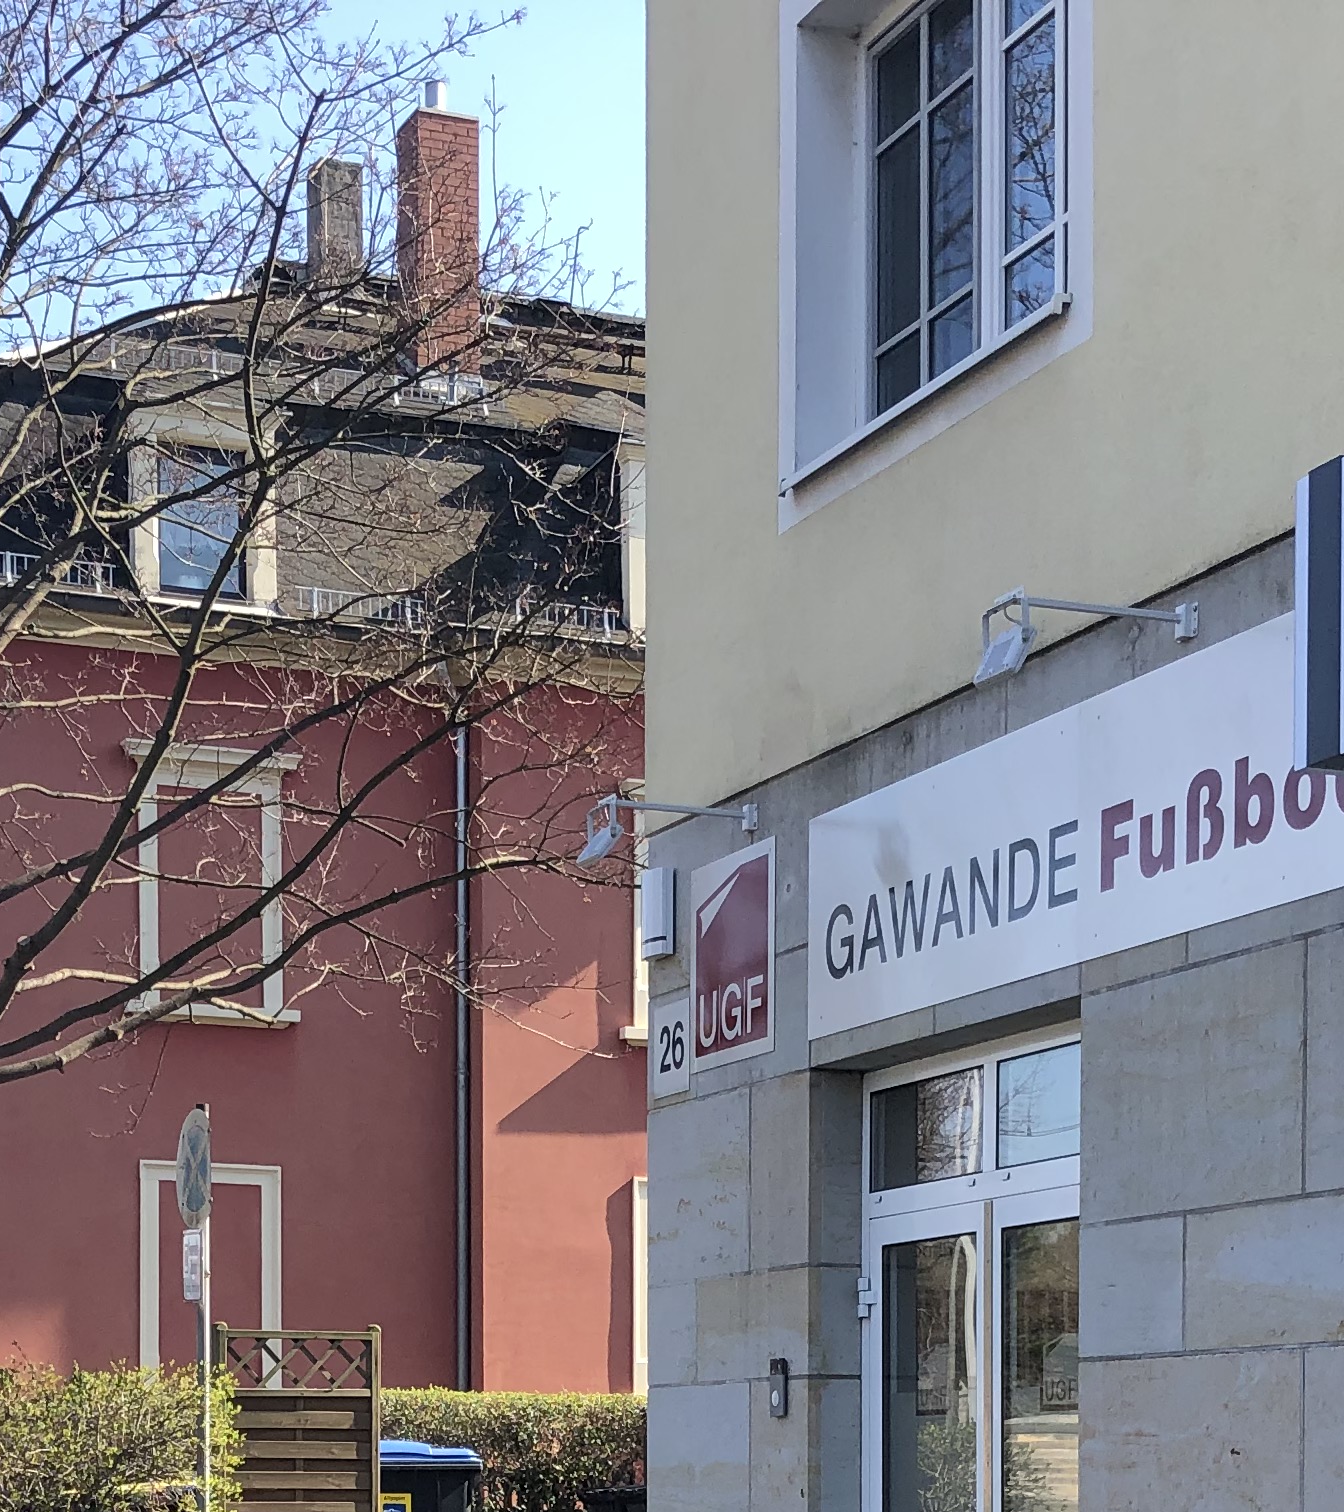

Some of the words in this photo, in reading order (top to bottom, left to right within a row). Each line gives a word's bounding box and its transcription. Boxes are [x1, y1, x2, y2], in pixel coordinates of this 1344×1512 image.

[825, 818, 1079, 980] GAWANDE
[659, 1020, 686, 1075] 26
[1044, 1378, 1078, 1402] UGF
